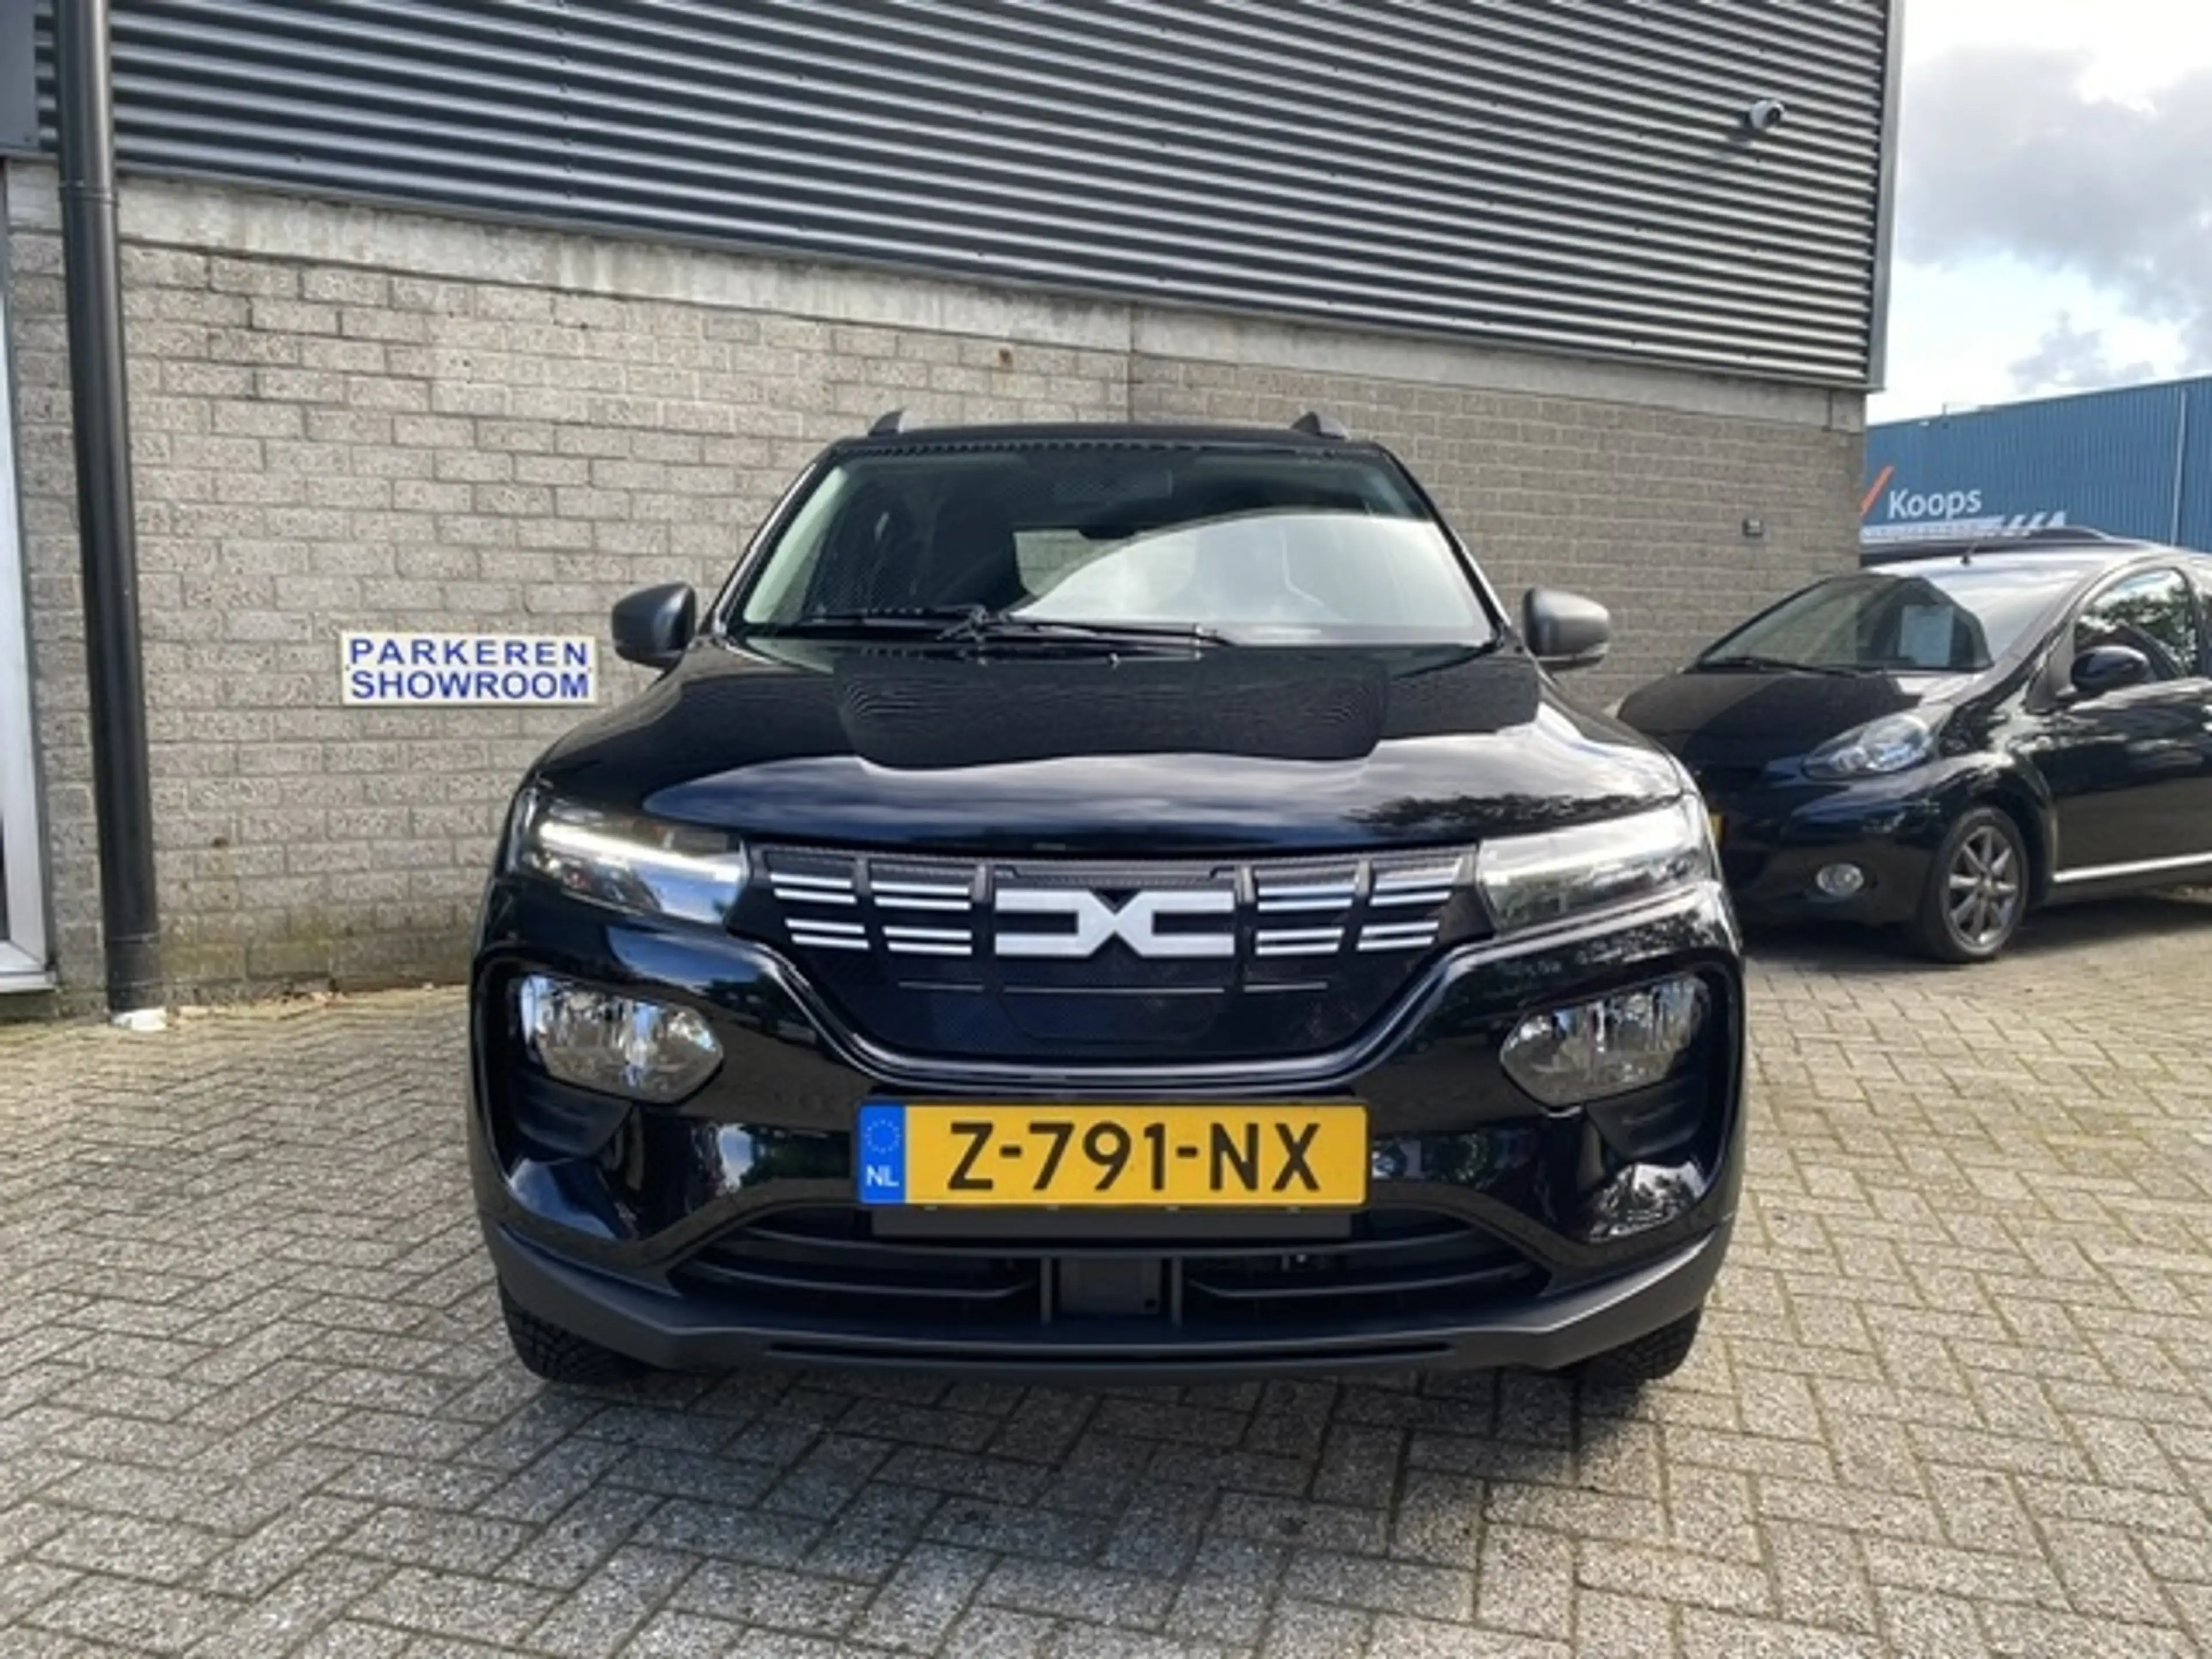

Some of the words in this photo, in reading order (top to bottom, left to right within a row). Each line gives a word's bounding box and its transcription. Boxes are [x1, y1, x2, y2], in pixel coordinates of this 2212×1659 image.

[1888, 489, 1982, 521] Koops
[350, 638, 587, 666] PARKEREN
[351, 669, 589, 699] SHOWROOM
[946, 1122, 1321, 1192] Z-791-NX
[865, 1167, 900, 1187] NL
